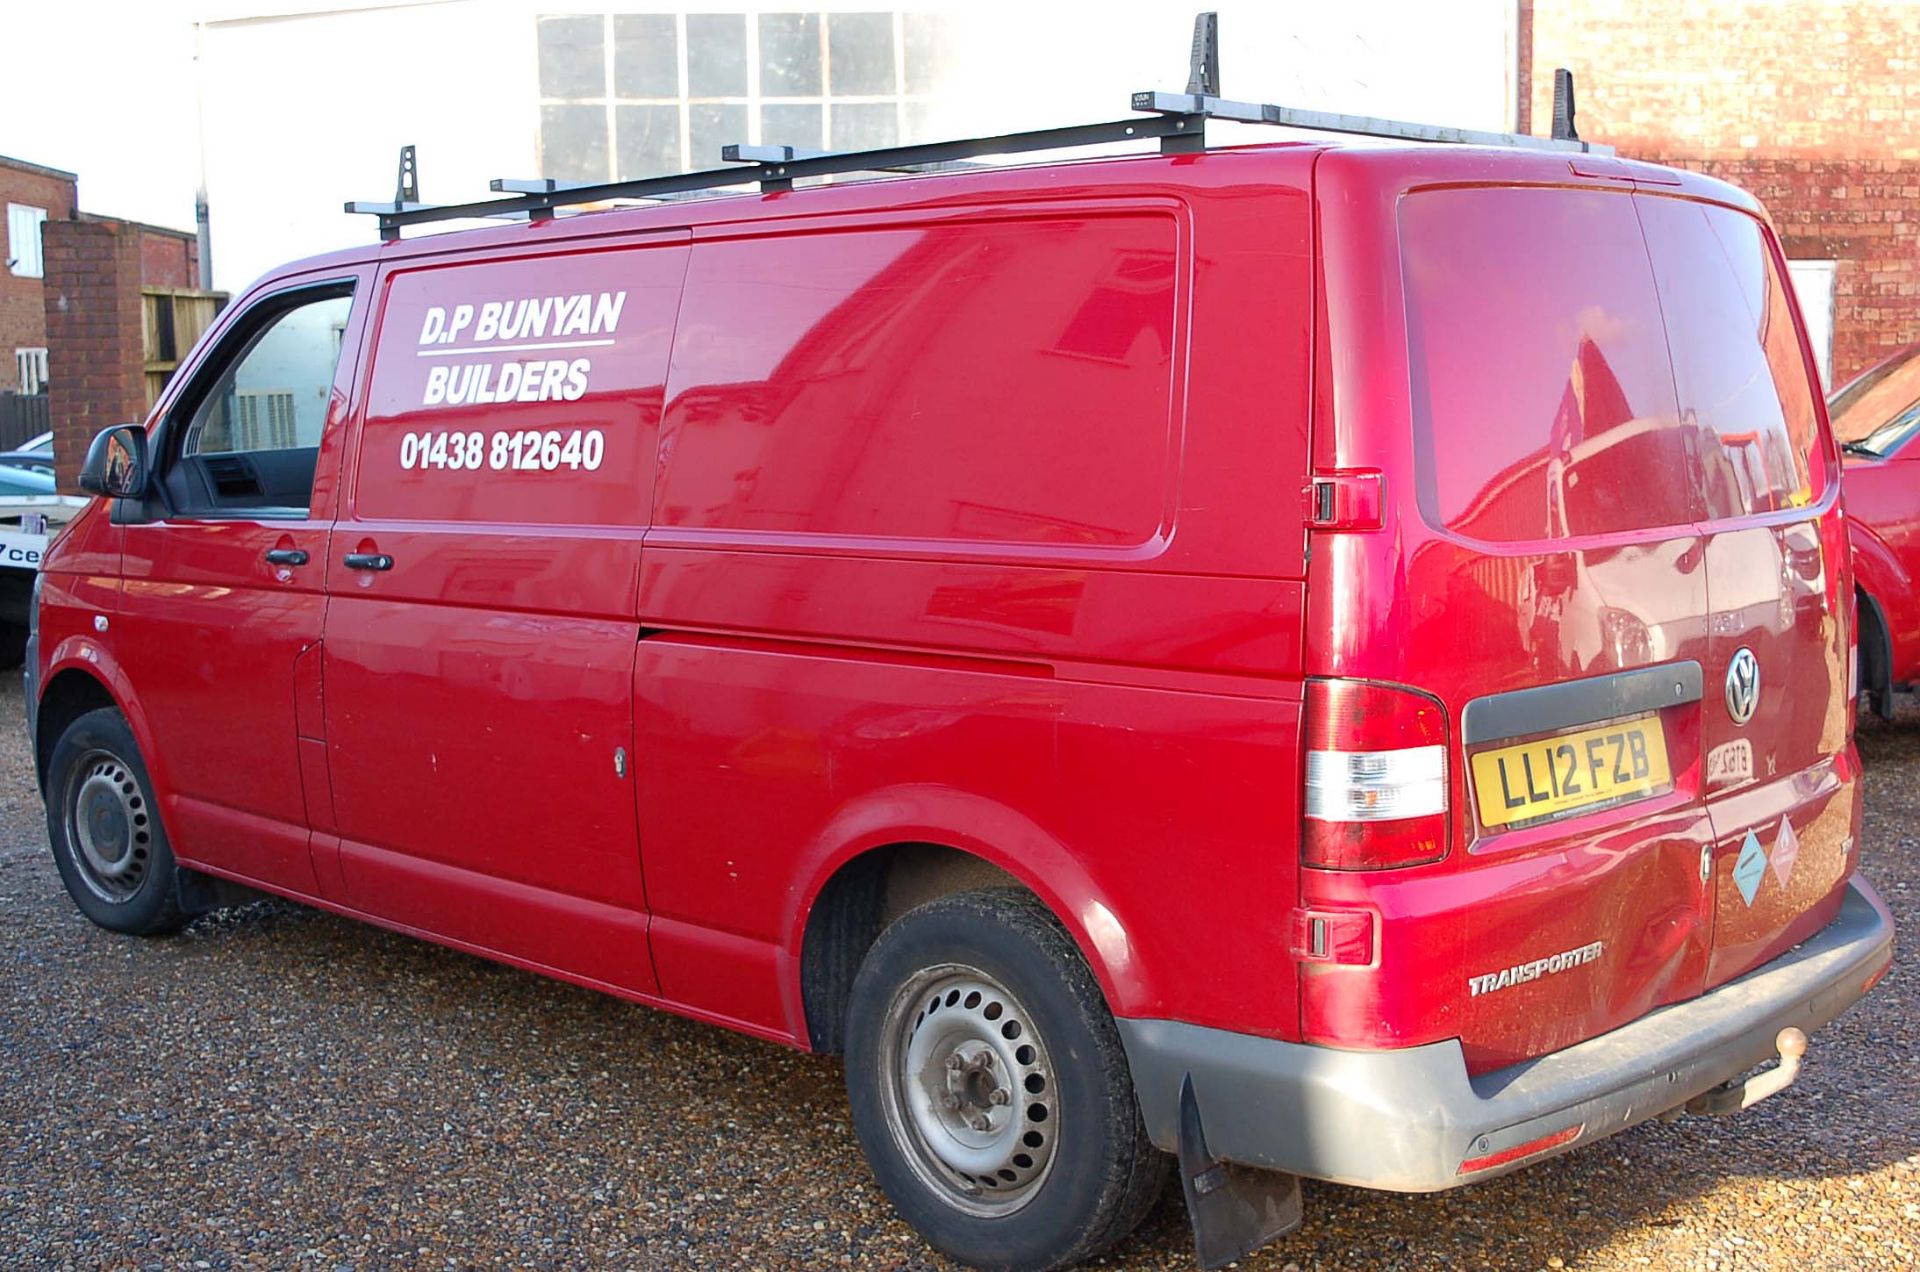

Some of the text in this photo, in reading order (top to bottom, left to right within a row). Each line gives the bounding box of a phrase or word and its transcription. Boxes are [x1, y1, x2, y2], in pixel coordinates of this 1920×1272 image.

[418, 291, 627, 345] D.P BUNYAN
[422, 358, 591, 405] BUILDERS
[400, 430, 604, 471] 01438 812640
[1497, 730, 1650, 809] LL12 FZB
[1468, 940, 1603, 997] TRANSPORTER
